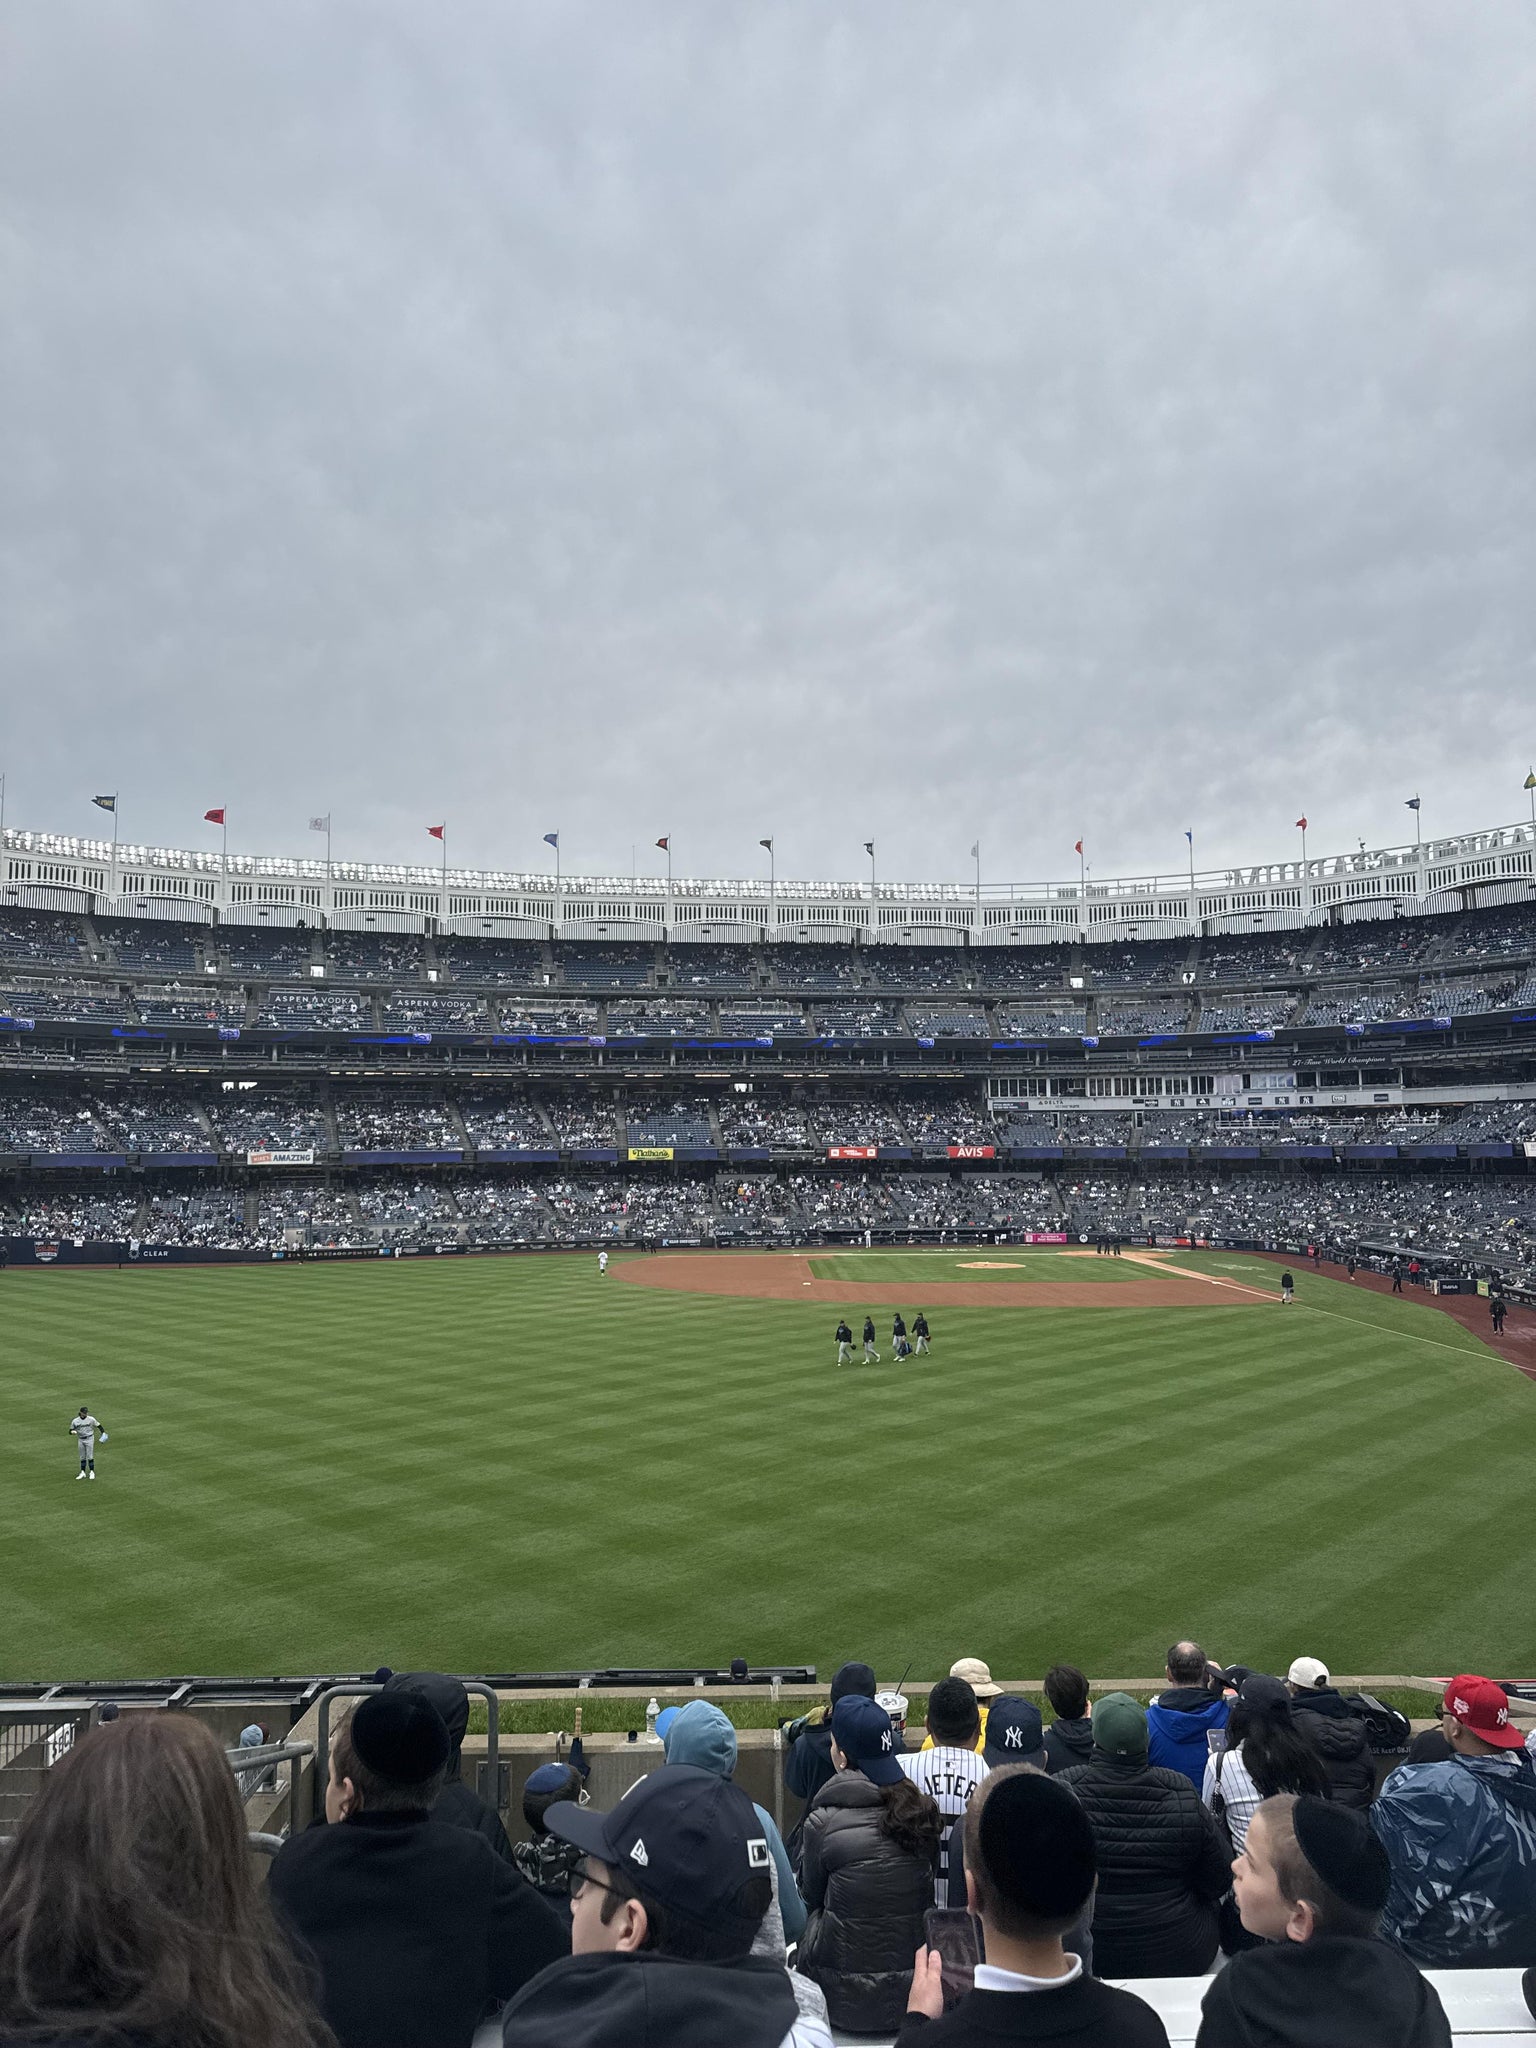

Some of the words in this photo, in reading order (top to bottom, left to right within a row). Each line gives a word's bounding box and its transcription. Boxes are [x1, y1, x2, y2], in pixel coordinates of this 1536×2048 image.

[1324, 1056, 1346, 1065] World
[1347, 1056, 1386, 1066] Champions
[273, 1154, 311, 1162] AMAZING
[632, 1149, 669, 1158] Nathan's
[957, 1148, 983, 1157] AVIS
[1496, 1707, 1508, 1726] NY
[881, 1729, 893, 1751] NY
[1004, 1725, 1024, 1749] NY
[924, 1773, 978, 1800] JETER
